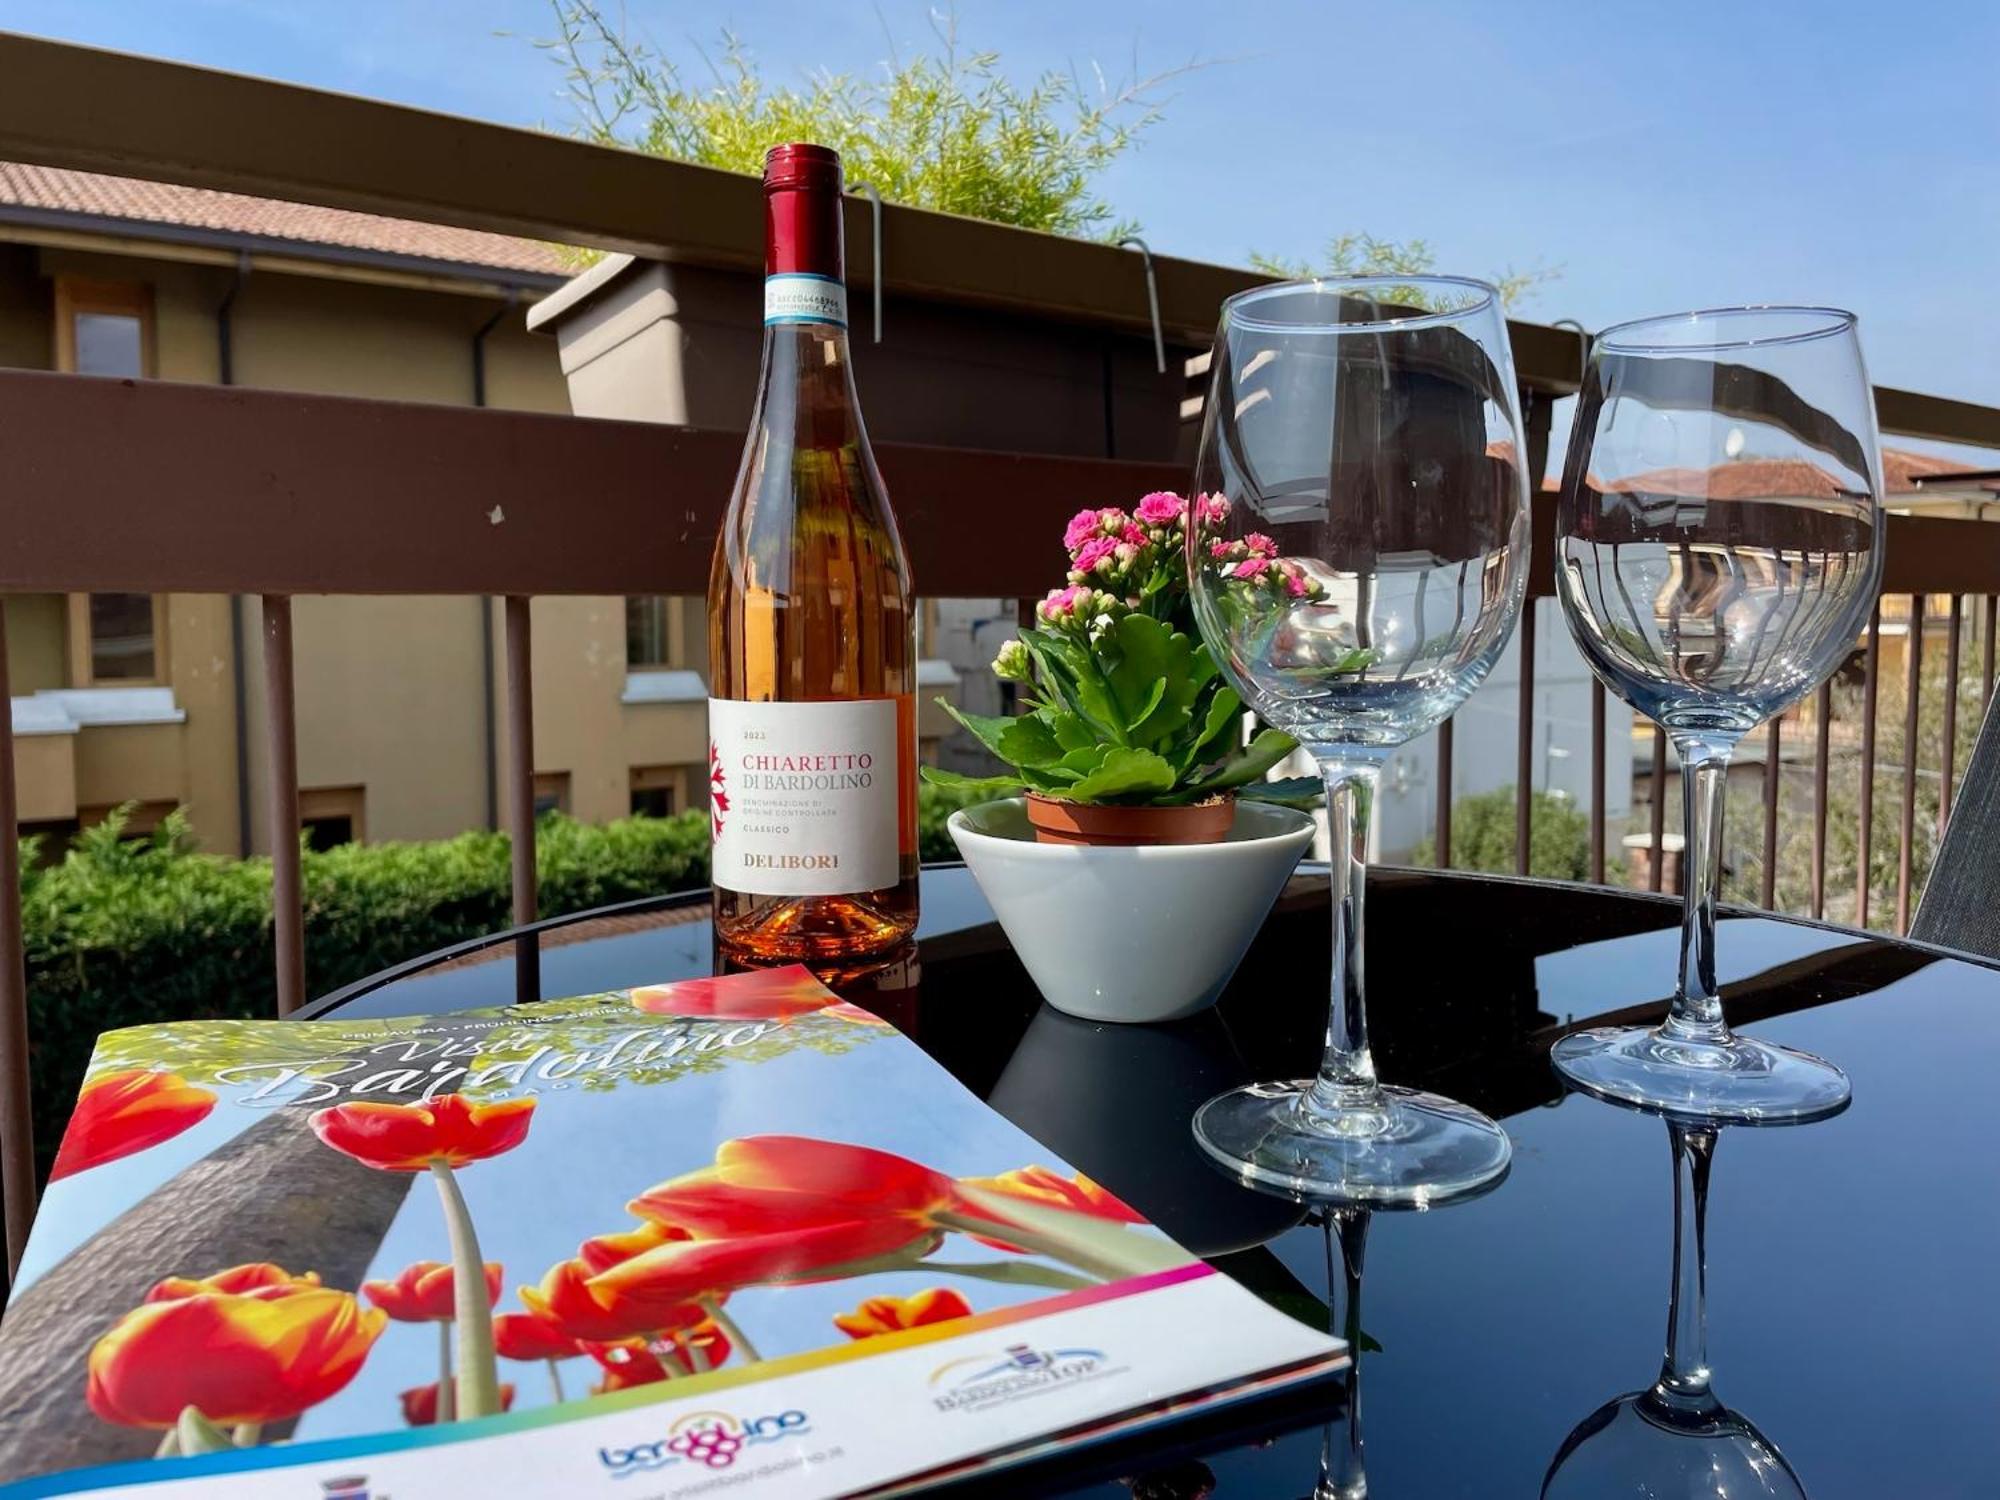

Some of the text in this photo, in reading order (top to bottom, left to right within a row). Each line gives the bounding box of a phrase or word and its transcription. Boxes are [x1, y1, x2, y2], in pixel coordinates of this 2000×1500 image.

[743, 753, 873, 772] CHIARETTO
[743, 773, 872, 791] DI BARDOLINO
[743, 824, 790, 834] CLASSICO
[744, 853, 839, 870] DELIBORI
[342, 1026, 447, 1040] PRIMAVERA
[370, 1032, 534, 1062] Visit
[214, 1022, 788, 1108] Bardolino
[489, 1059, 702, 1100] MAGAZINE
